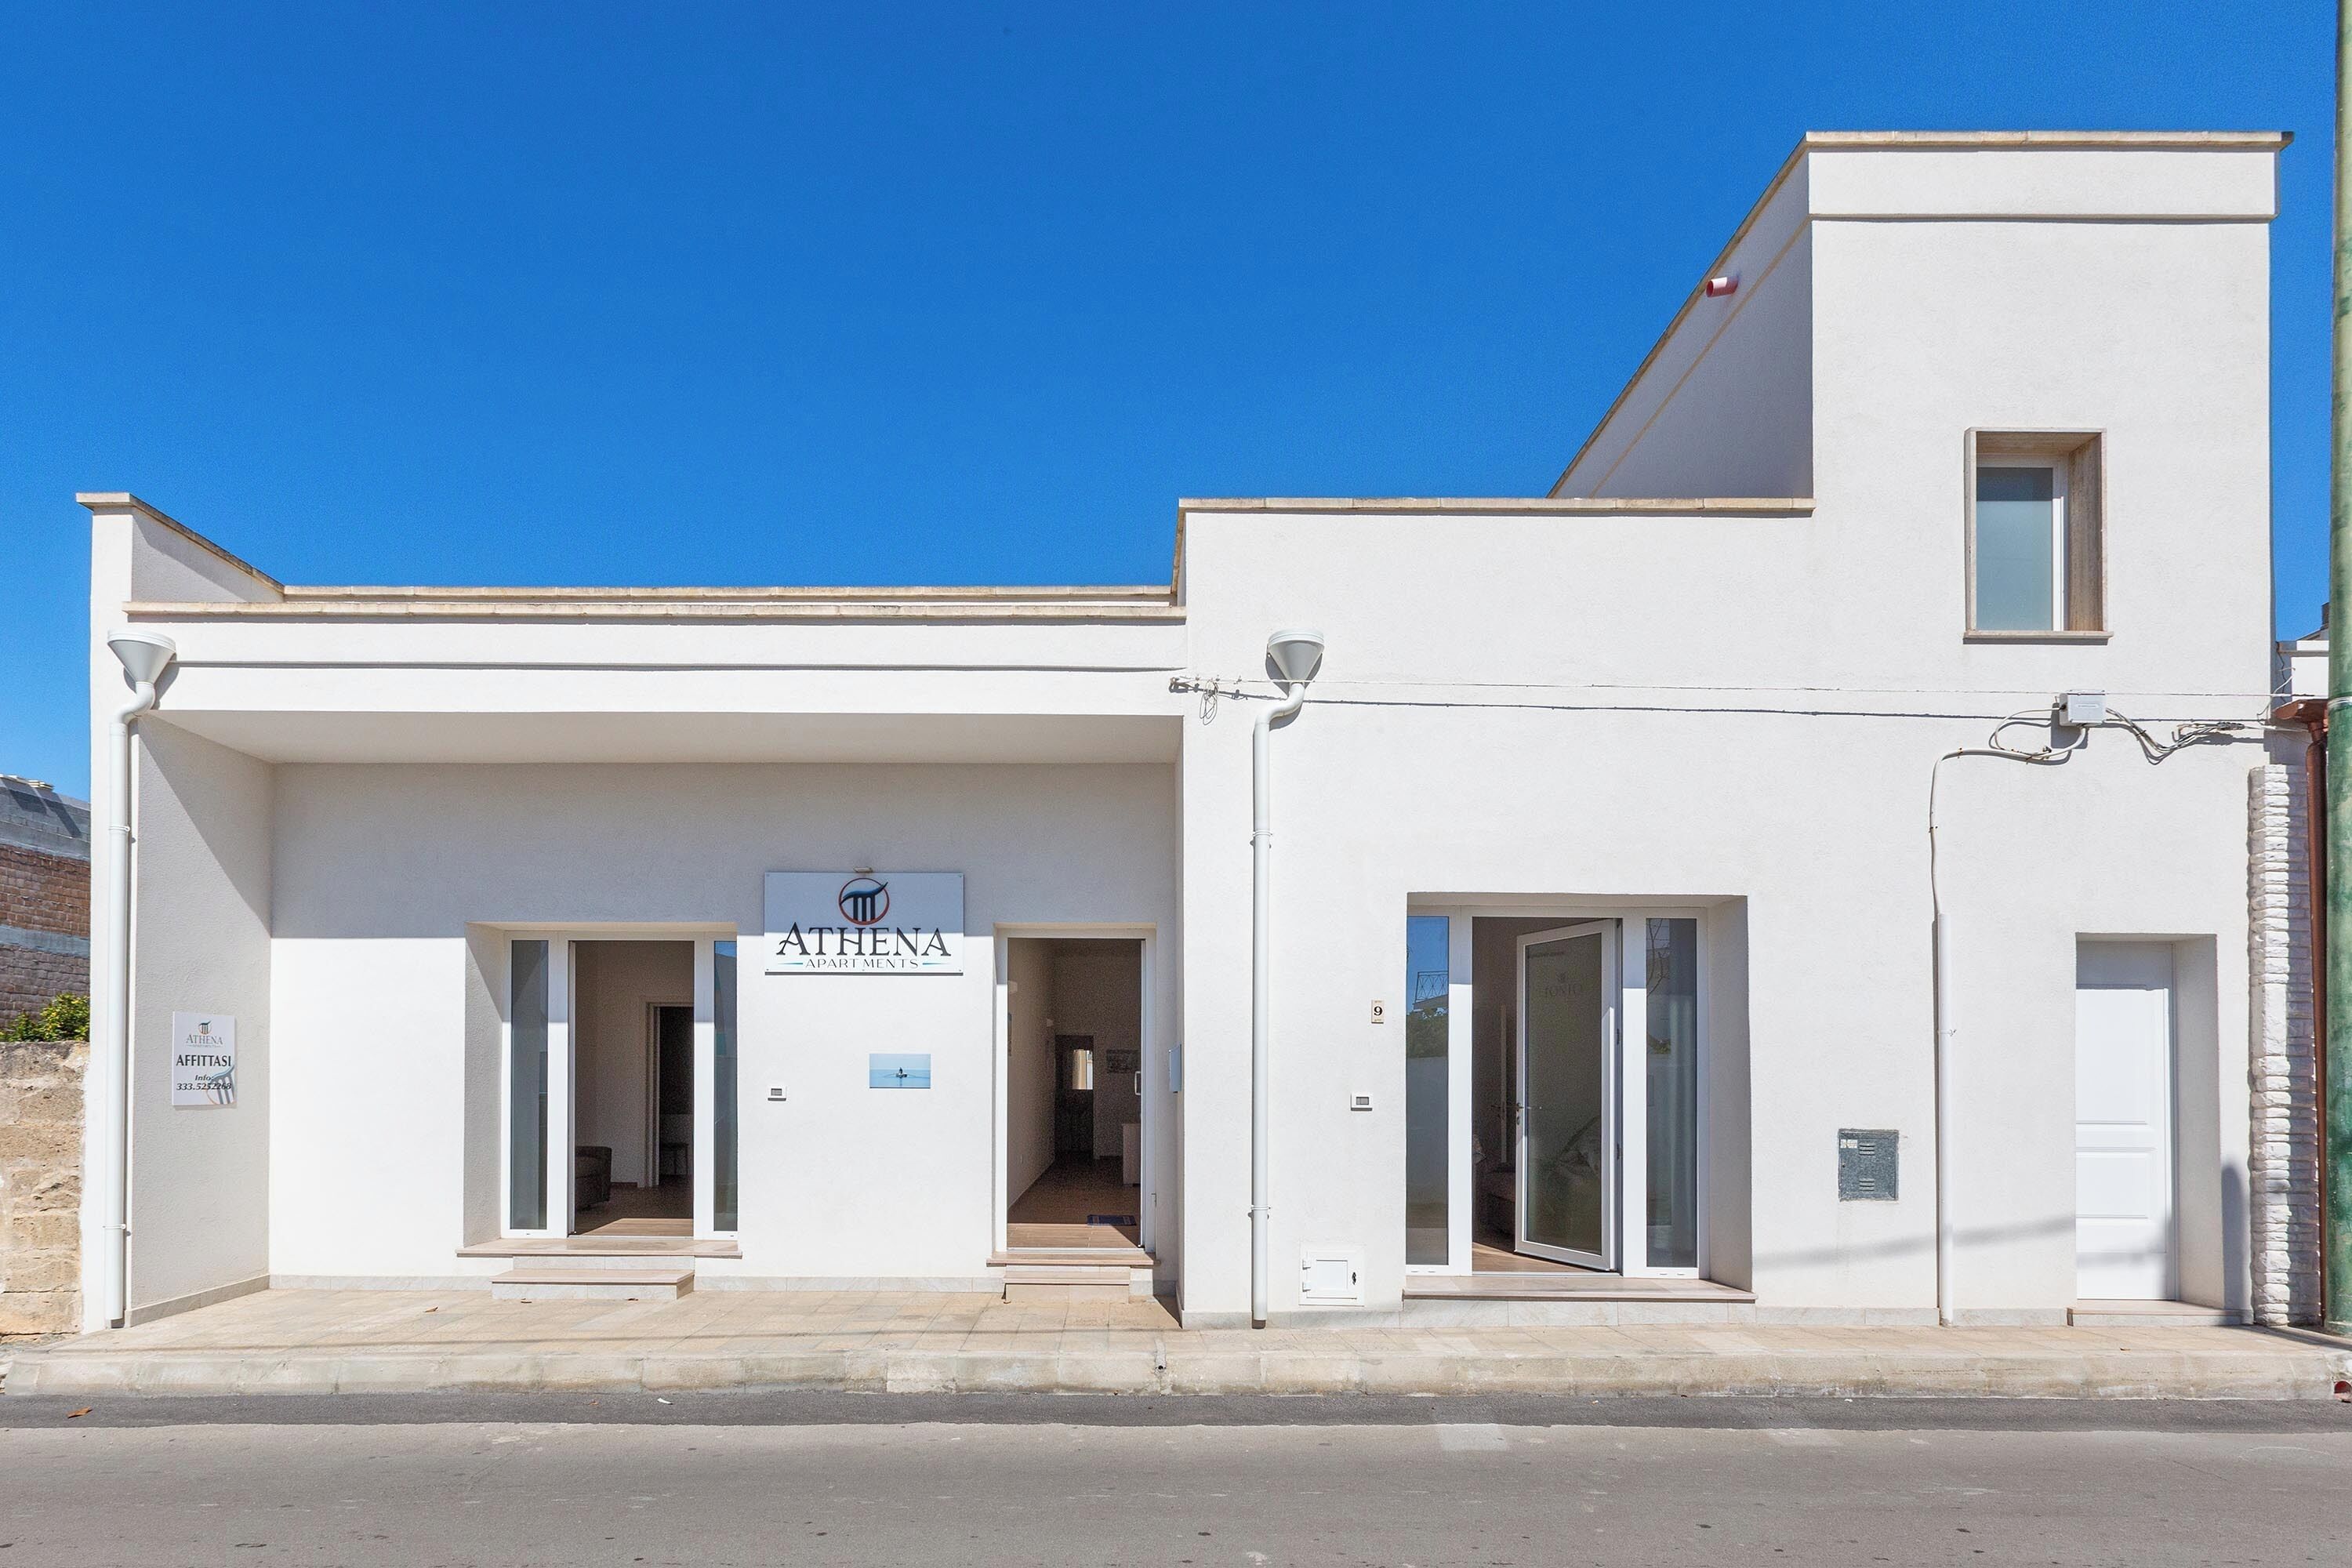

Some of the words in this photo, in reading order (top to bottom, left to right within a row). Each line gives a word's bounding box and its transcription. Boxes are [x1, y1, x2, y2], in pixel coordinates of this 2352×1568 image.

[776, 921, 952, 956] ATHENA
[805, 958, 919, 968] APARTMENTS
[1374, 1006, 1383, 1016] 9
[186, 1034, 223, 1044] ATHENA
[176, 1054, 231, 1066] AFFITTASI
